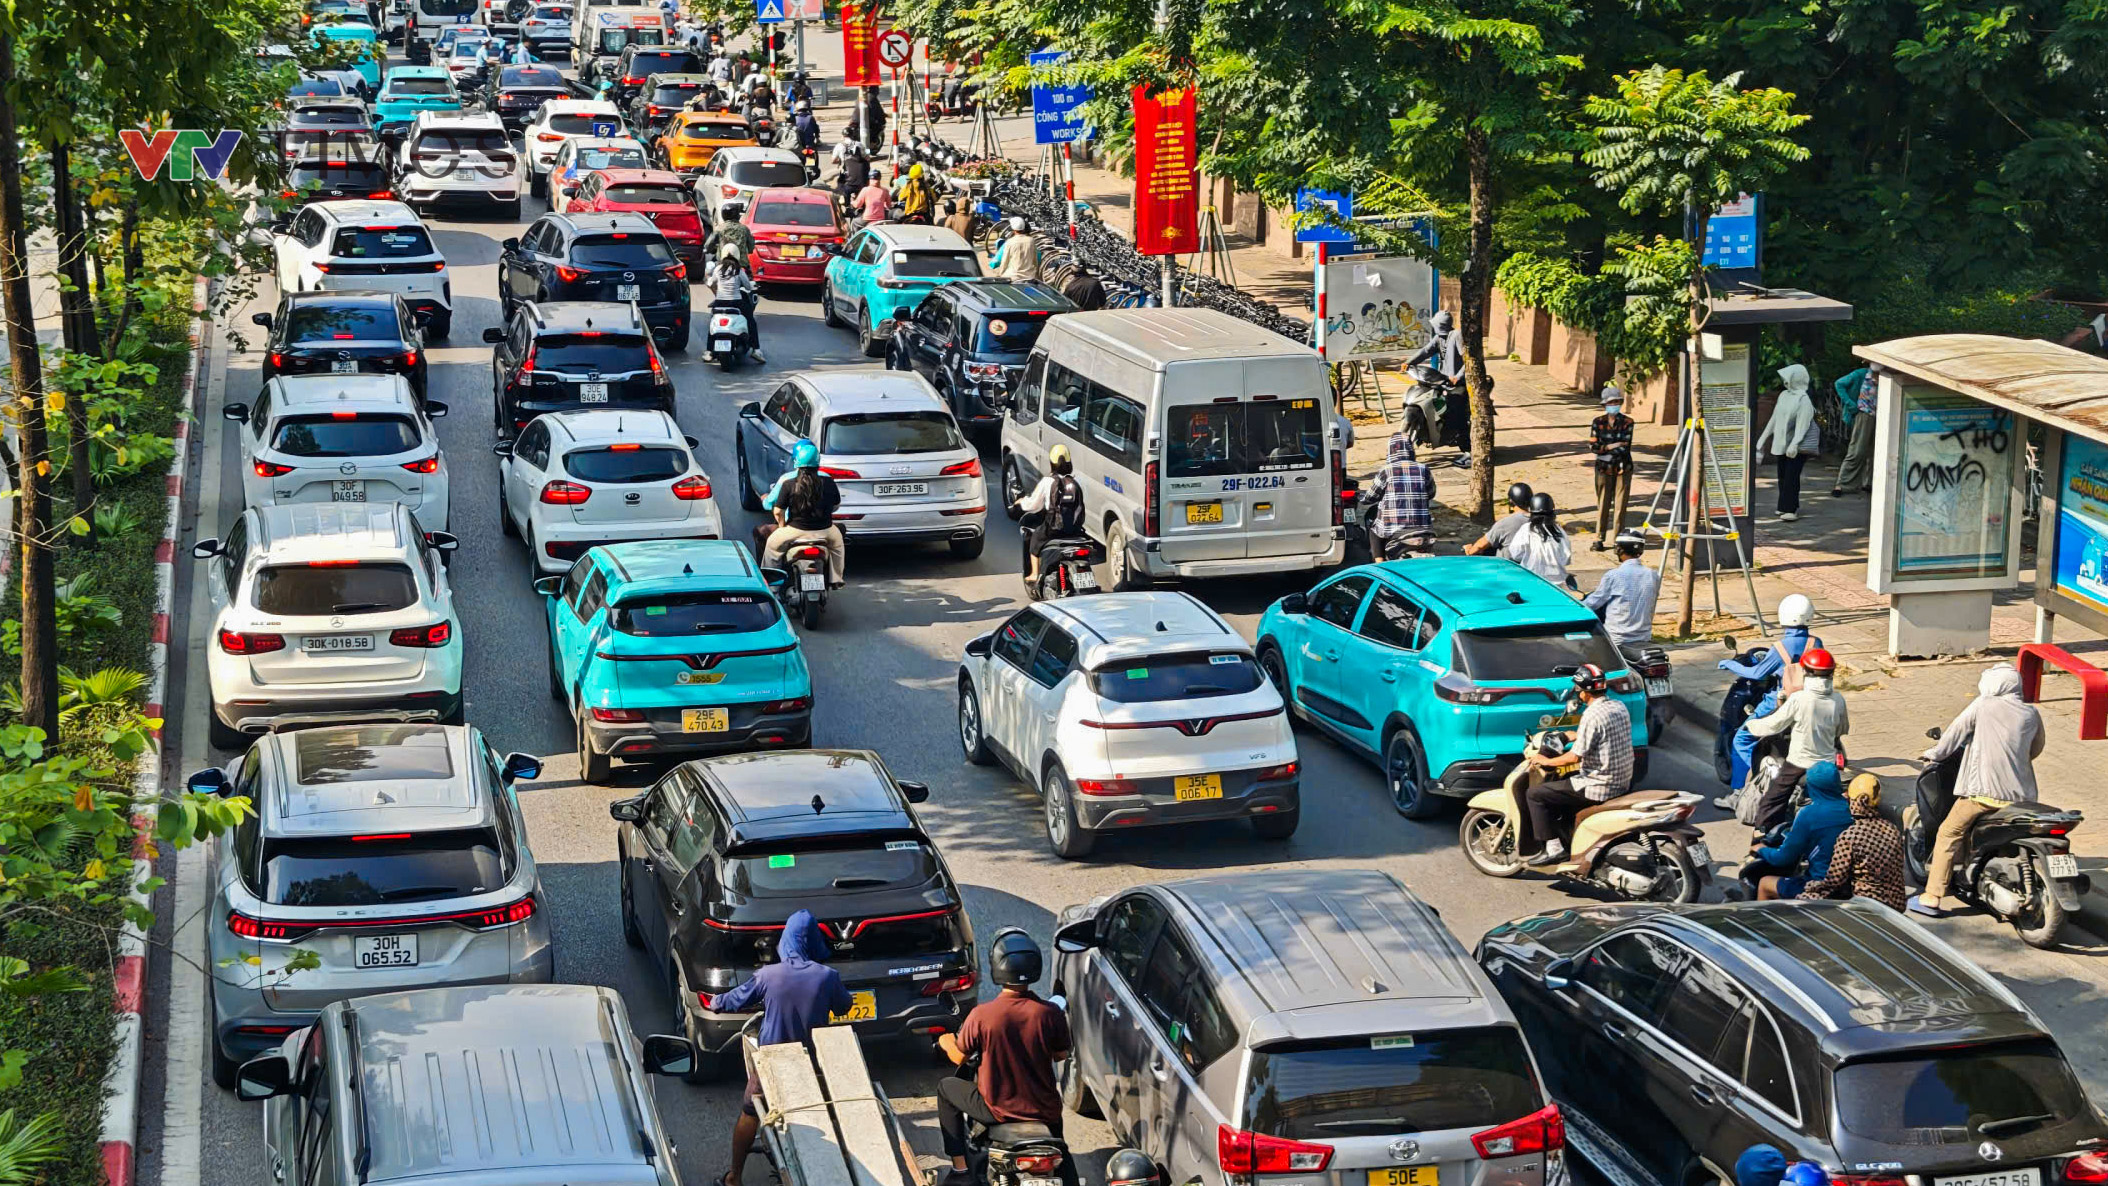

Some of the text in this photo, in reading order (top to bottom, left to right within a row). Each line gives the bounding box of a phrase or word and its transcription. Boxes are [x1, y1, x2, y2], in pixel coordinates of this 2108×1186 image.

[1036, 110, 1058, 123] CÔNG
[586, 384, 602, 393] 30E
[340, 481, 356, 491] 30F
[878, 485, 923, 494] 30F-263.96
[1221, 476, 1286, 491] 29F-022.64
[308, 638, 368, 649] 30K-018.58
[695, 709, 715, 721] 29E
[688, 720, 724, 732] 470.43
[1188, 776, 1208, 788] 35E
[1181, 787, 1217, 799] 006.17
[373, 937, 400, 951] 30H
[362, 950, 411, 966] 065.52
[1388, 1168, 1418, 1186] 50E
